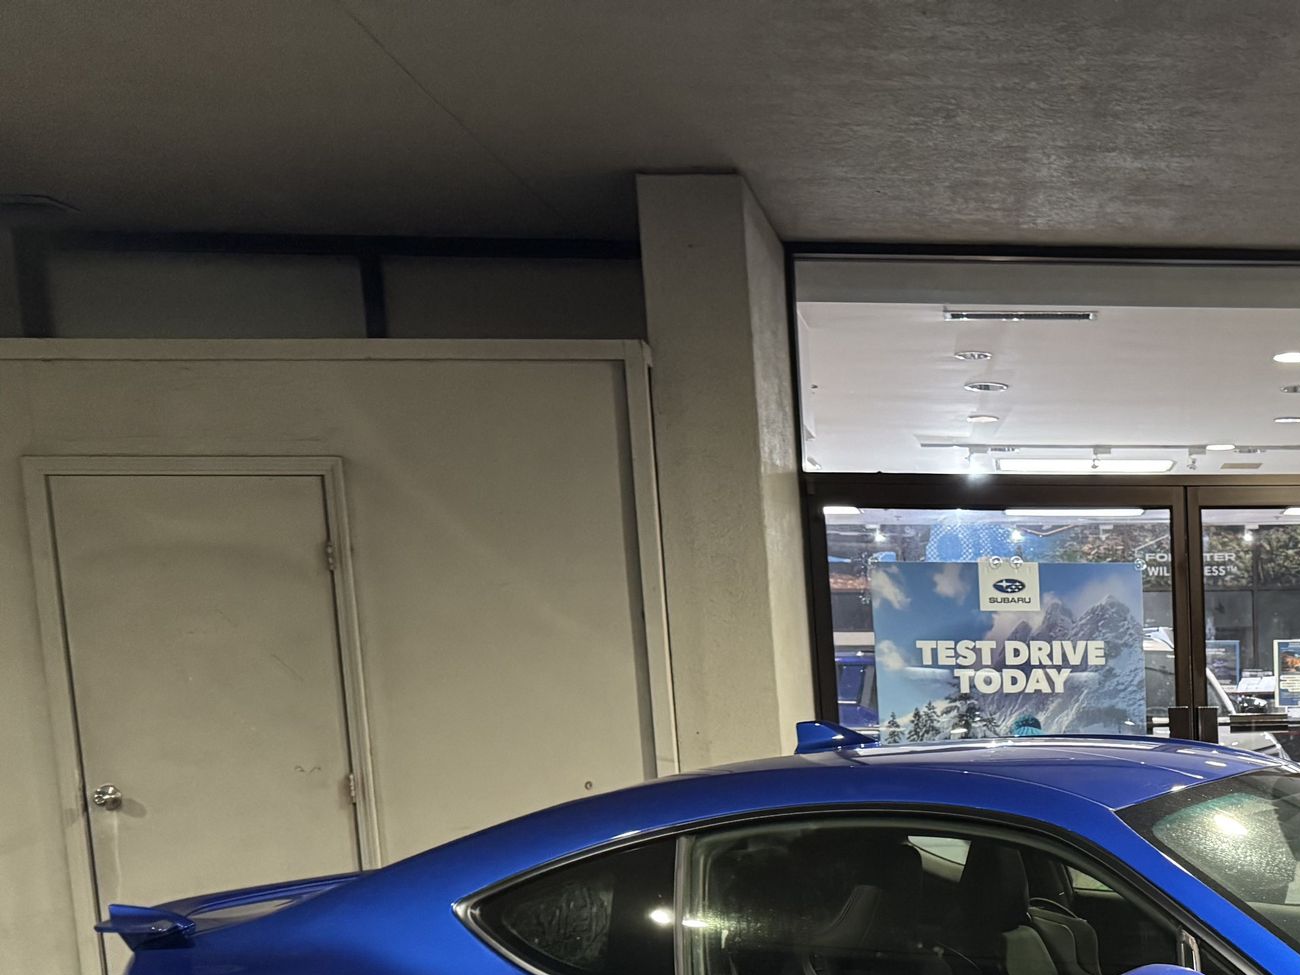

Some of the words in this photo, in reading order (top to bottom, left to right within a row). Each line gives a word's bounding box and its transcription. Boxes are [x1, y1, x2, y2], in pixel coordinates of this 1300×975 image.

[988, 596, 1031, 604] SUBARU
[915, 640, 997, 666] TEST
[1004, 640, 1106, 666] DRIVE
[954, 668, 1072, 694] TODAY
